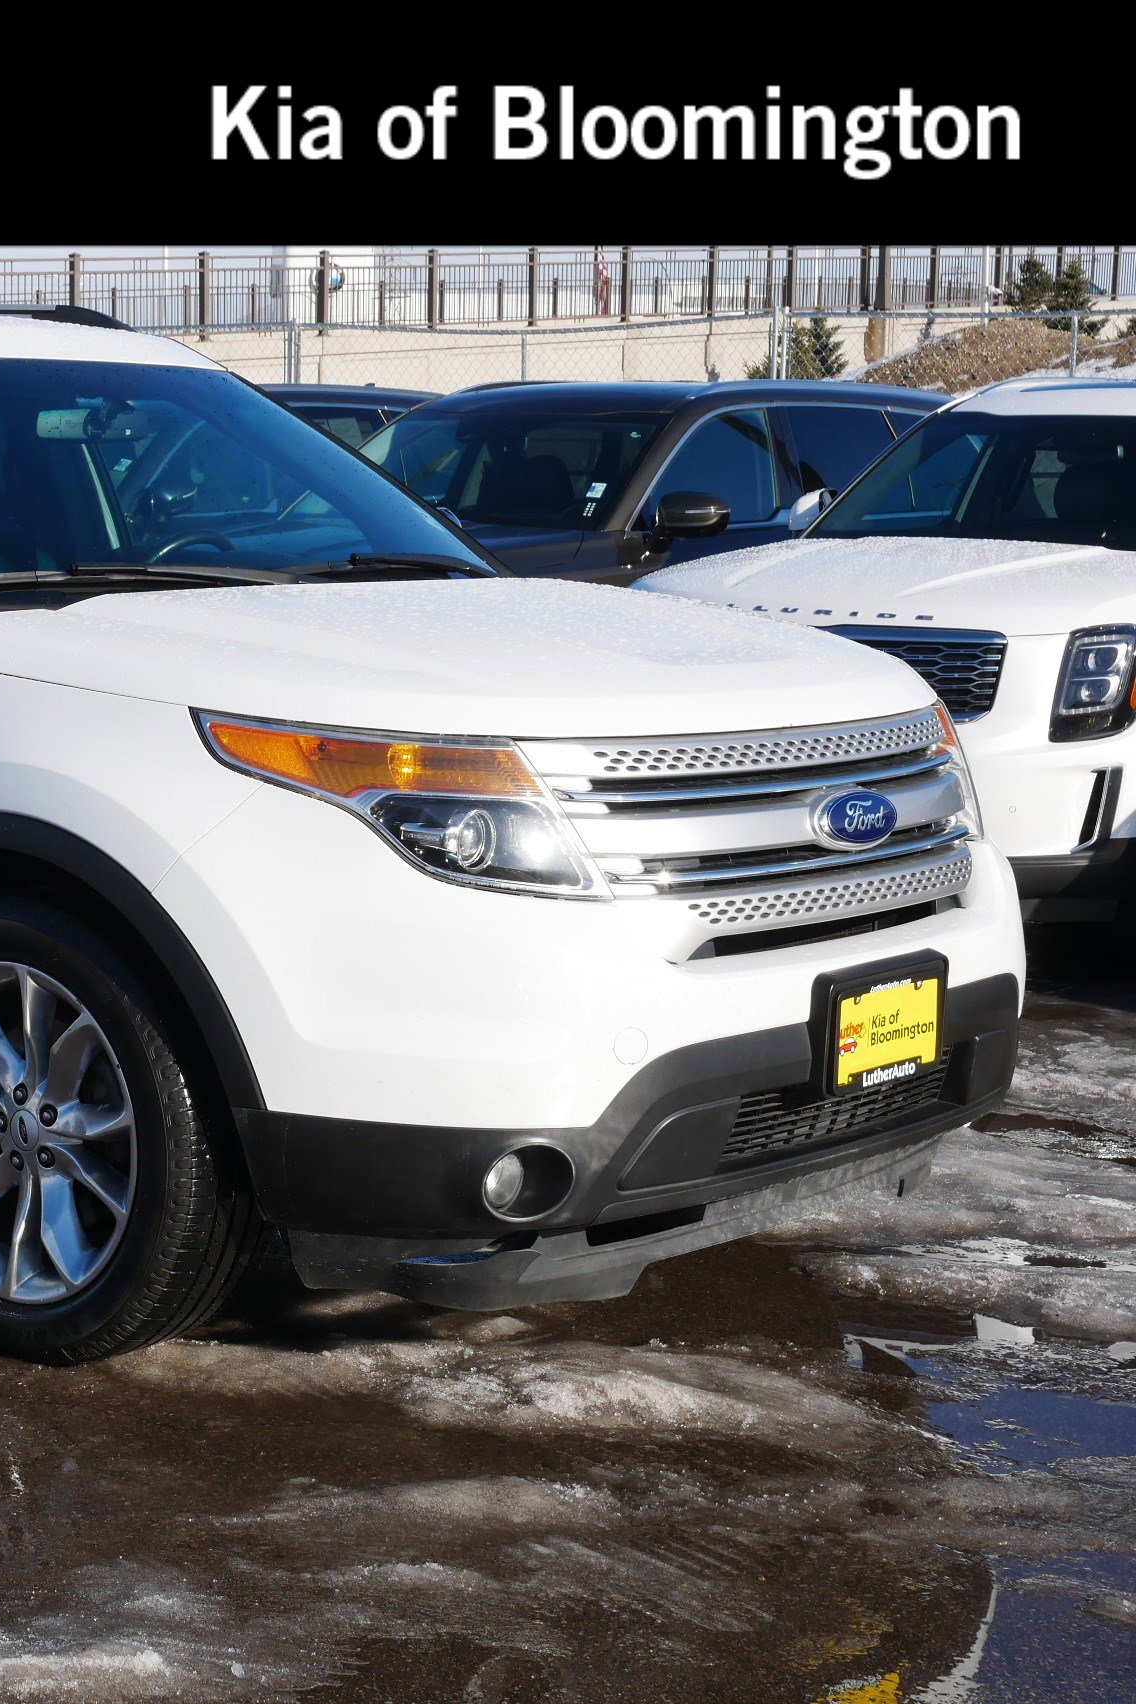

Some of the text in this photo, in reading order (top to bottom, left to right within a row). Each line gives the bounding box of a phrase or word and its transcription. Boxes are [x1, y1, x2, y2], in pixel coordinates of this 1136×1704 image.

[845, 800, 886, 832] Ford
[839, 1021, 864, 1039] uther
[872, 1009, 900, 1029] Kia of
[871, 1021, 934, 1047] Bloomington
[862, 1061, 916, 1087] LutherAuto
